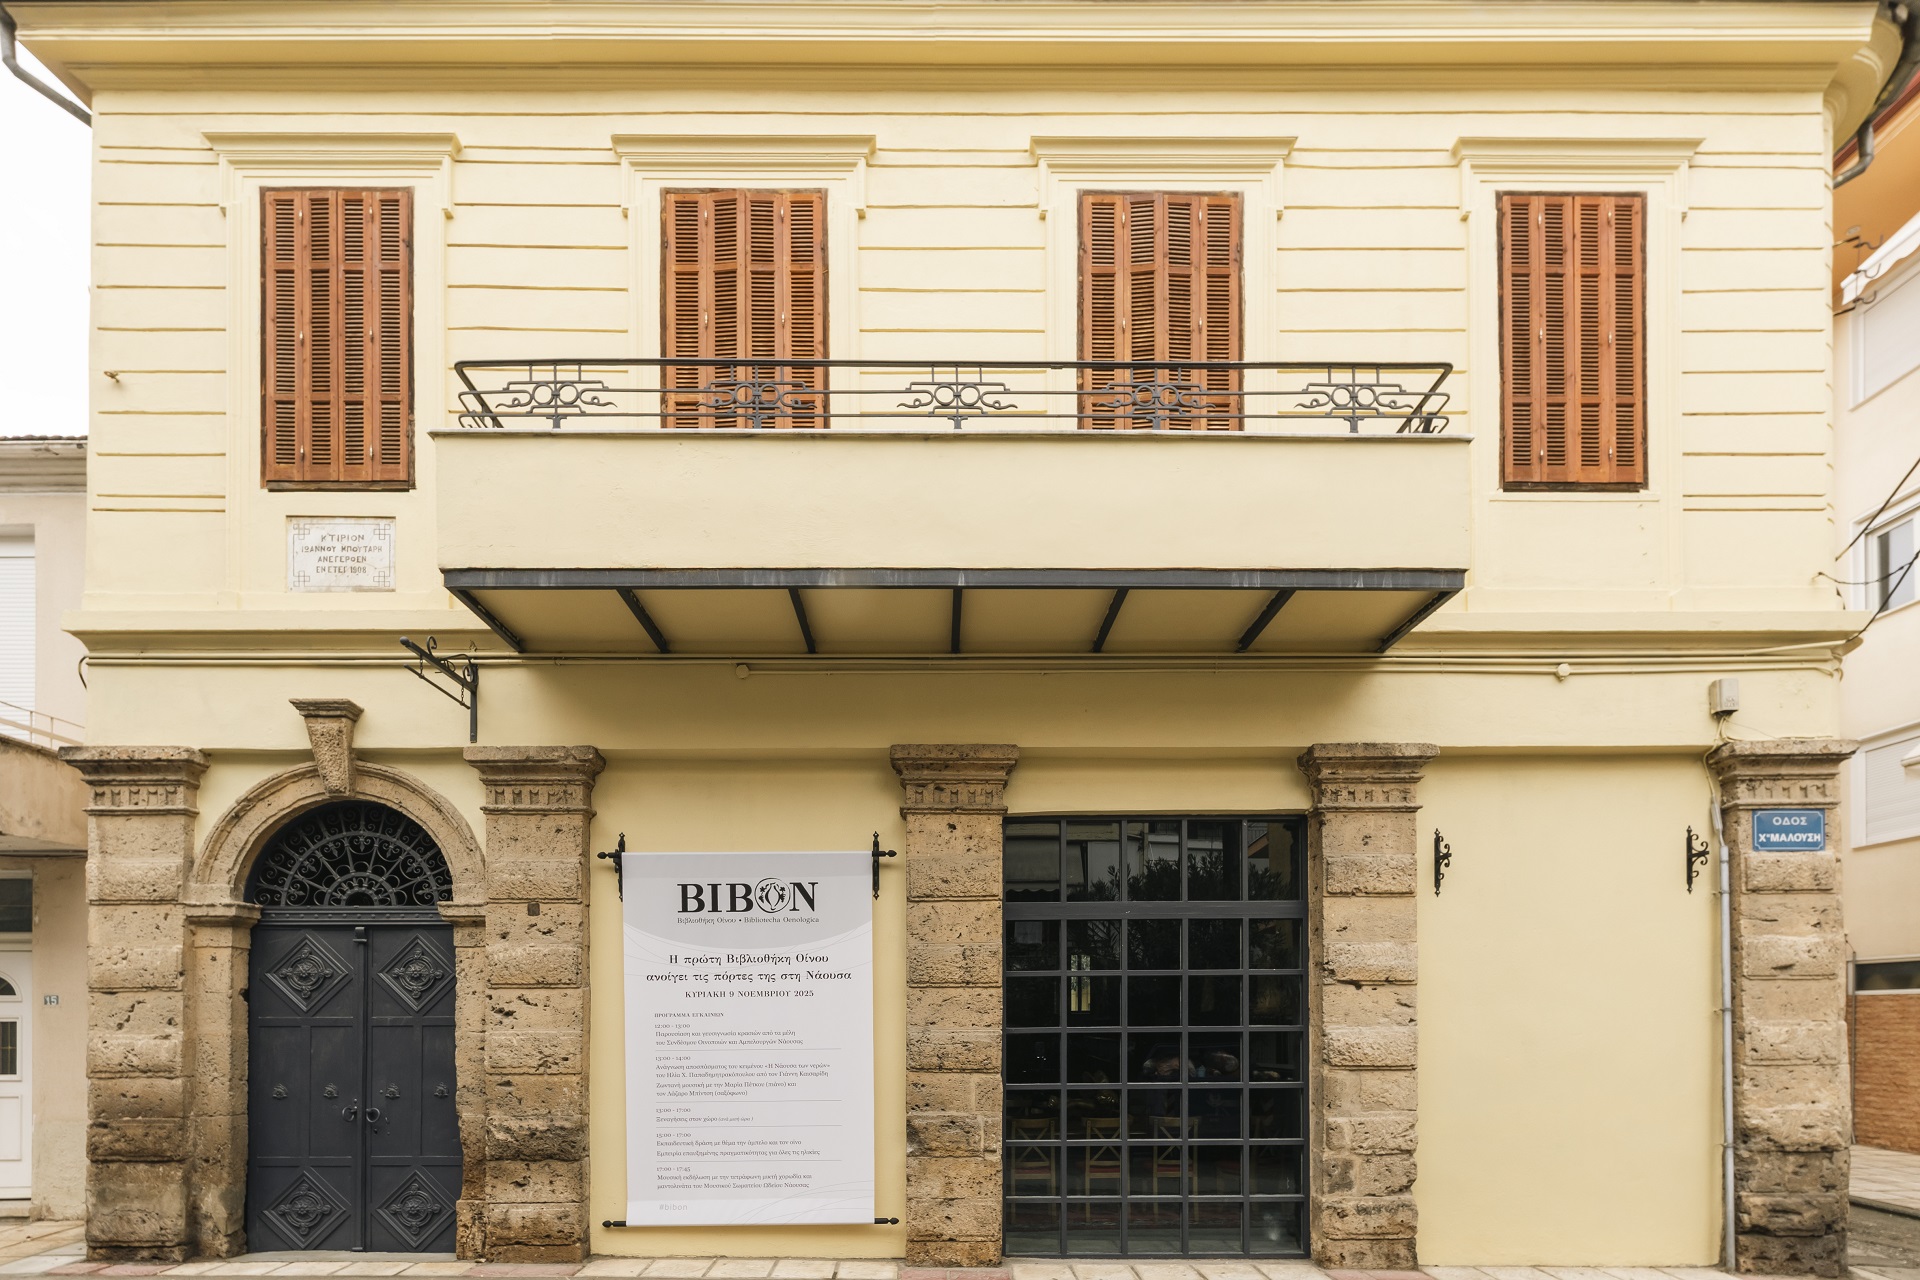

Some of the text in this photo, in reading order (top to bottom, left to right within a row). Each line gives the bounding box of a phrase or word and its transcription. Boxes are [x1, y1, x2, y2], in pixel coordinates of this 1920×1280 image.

[1772, 817, 1807, 825] ΟΔΟΣ
[783, 916, 819, 924] Oenologica
[669, 952, 829, 966] Η πρώτη Βιβλιοθήκη Οίνου
[646, 970, 852, 983] ανοίγει τις πόρτες της στη Νάουσα
[44, 995, 57, 1005] 15
